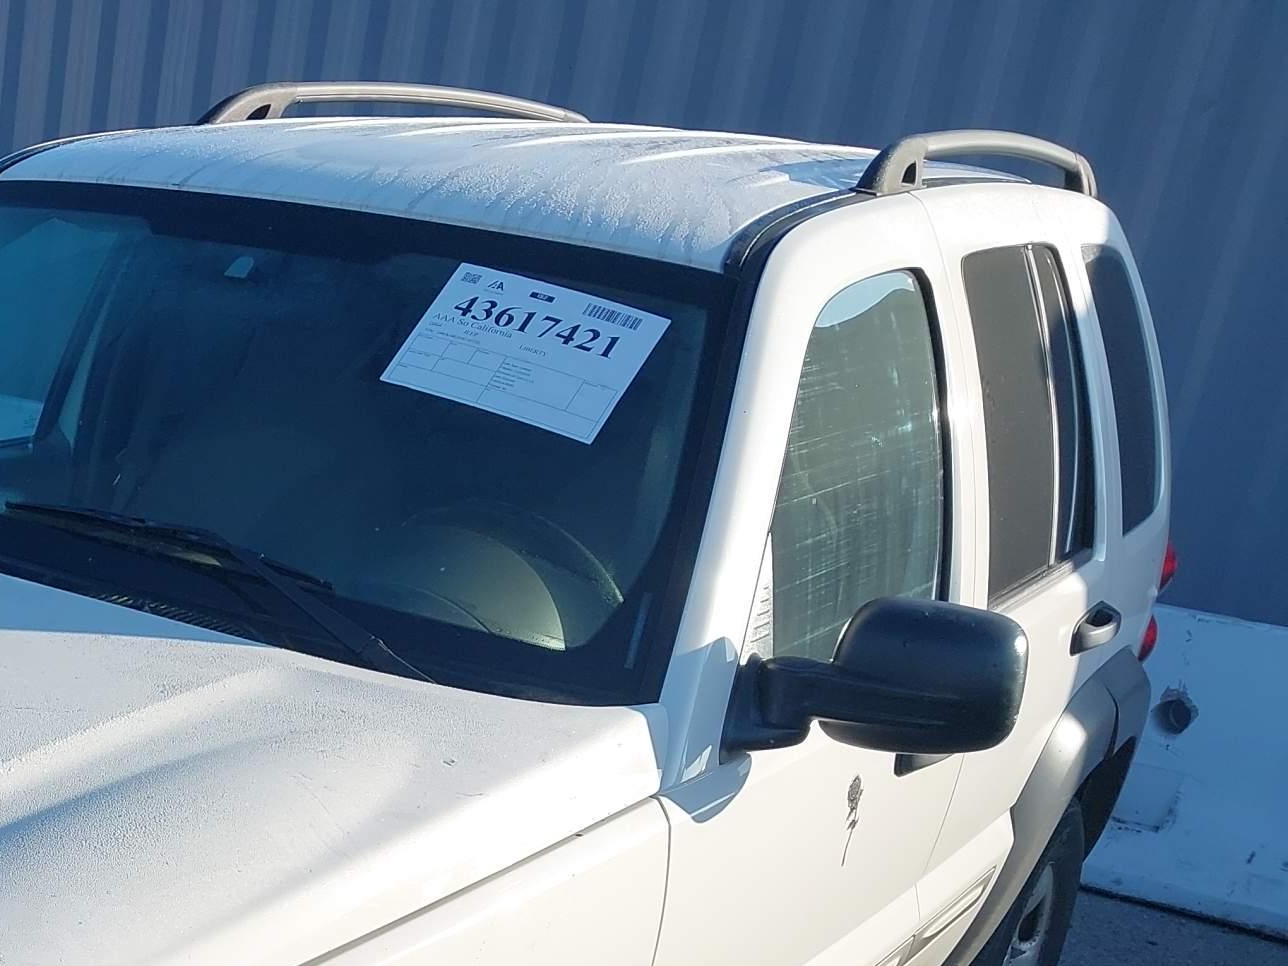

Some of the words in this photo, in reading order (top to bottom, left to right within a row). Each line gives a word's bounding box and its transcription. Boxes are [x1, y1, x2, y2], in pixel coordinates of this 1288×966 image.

[433, 313, 455, 323] AAA
[457, 318, 469, 326] So
[471, 322, 513, 339] California
[454, 296, 620, 359] 43617421
